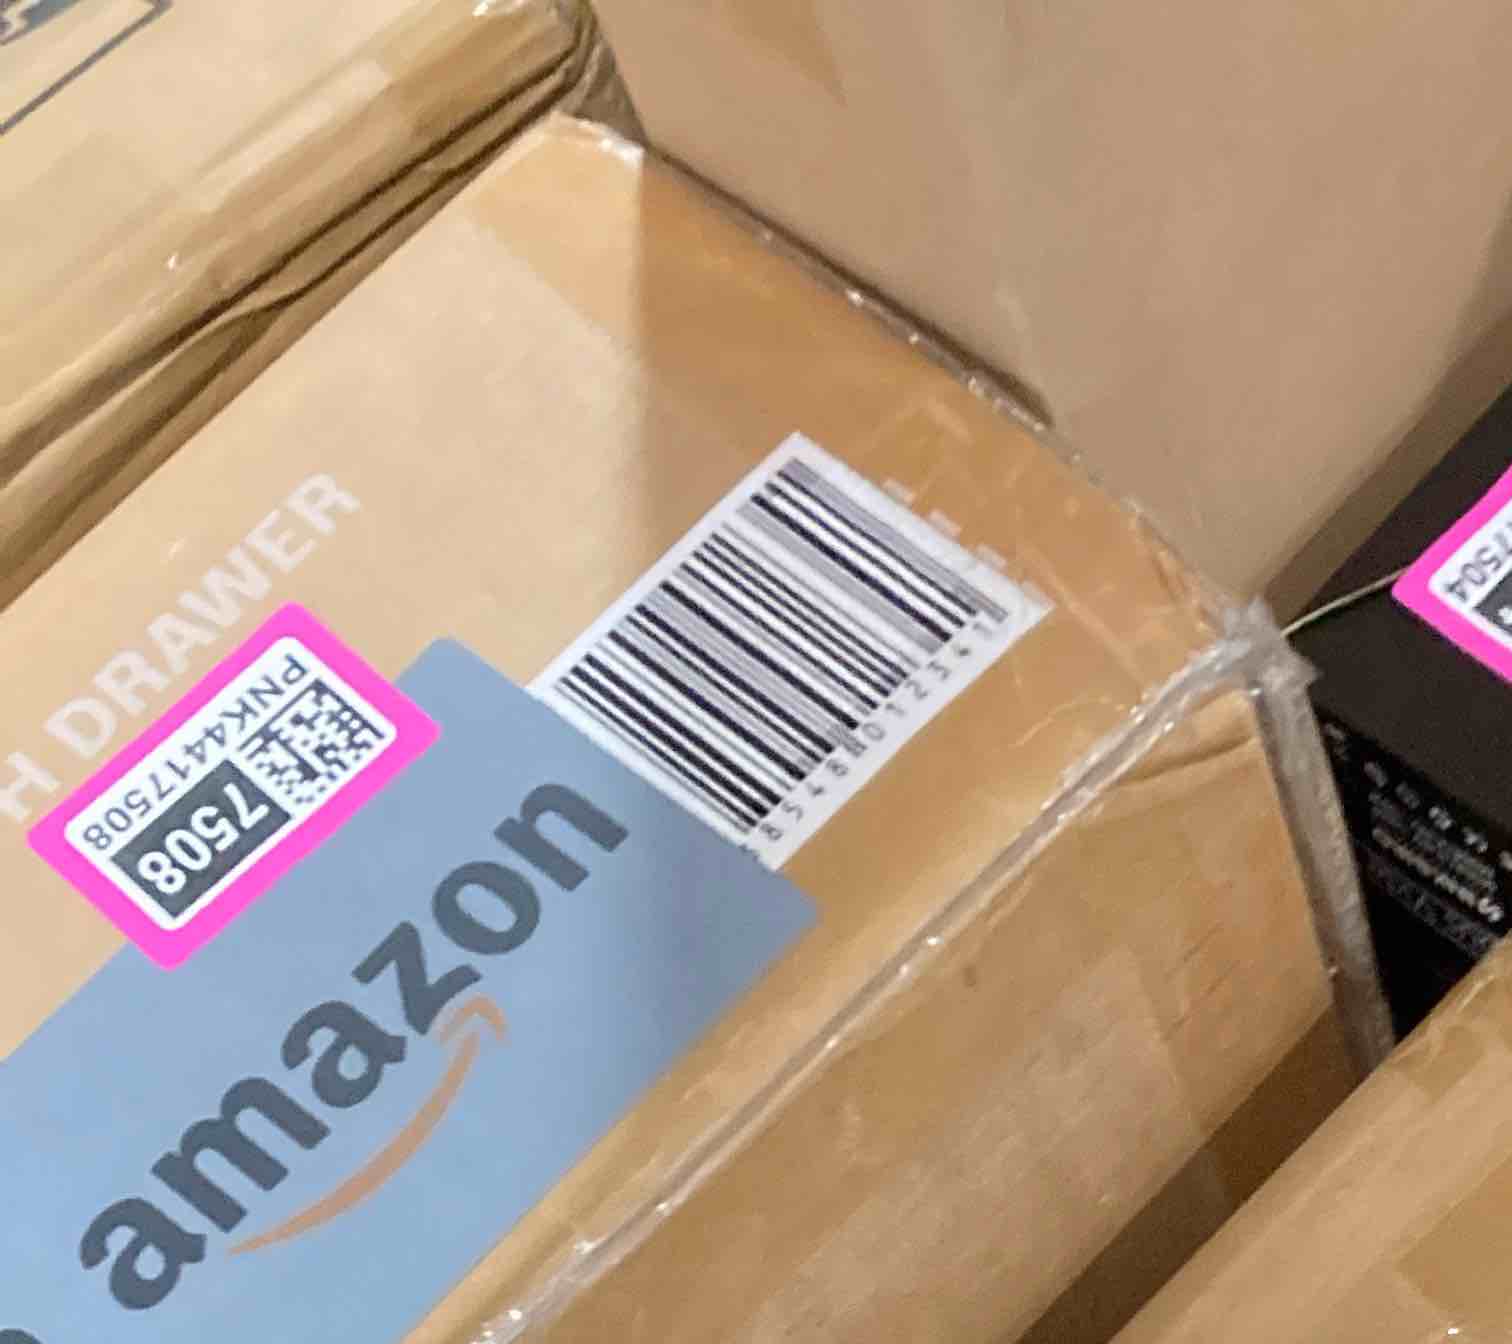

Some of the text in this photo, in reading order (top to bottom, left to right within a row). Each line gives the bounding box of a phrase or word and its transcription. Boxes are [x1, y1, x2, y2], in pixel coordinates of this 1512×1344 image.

[43, 472, 361, 759] DRAWER
[83, 653, 308, 851] PNK4417508
[136, 782, 270, 894] 7508
[80, 782, 629, 1310] amazon
